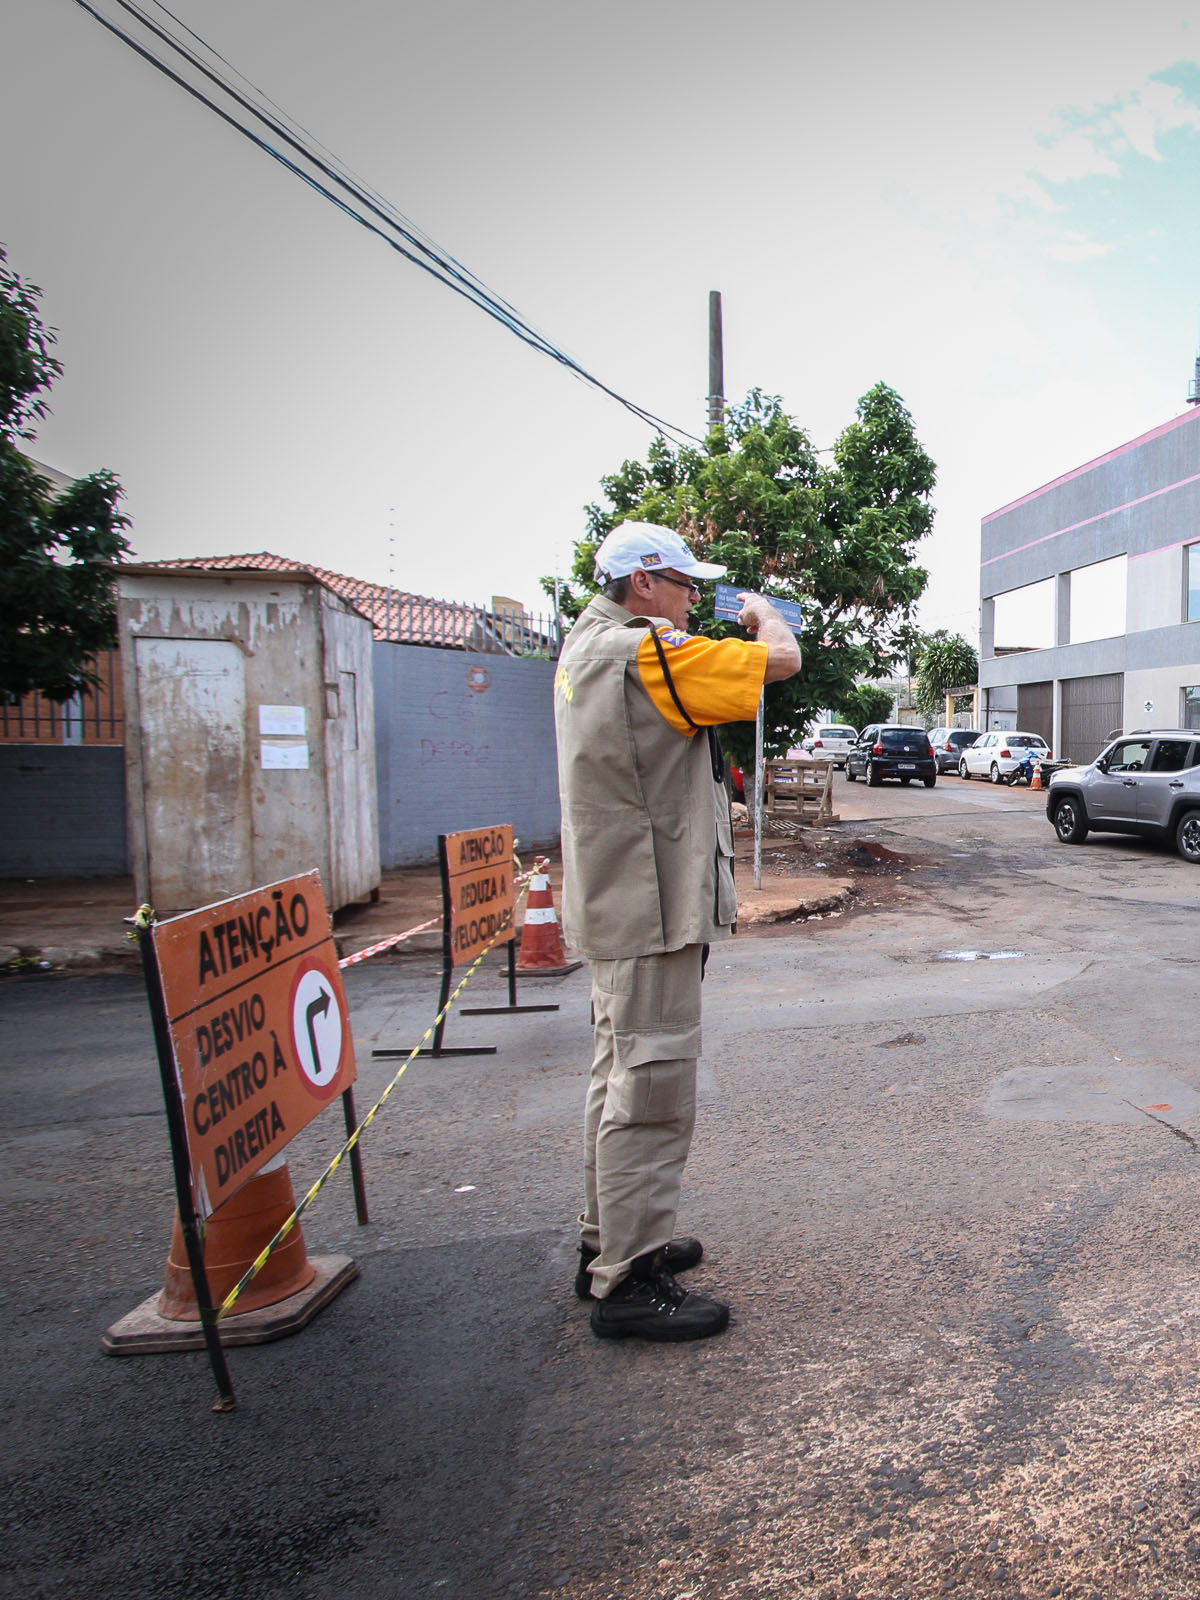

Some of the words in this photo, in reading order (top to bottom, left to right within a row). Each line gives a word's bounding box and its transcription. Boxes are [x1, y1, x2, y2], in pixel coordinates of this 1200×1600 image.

[460, 830, 505, 865] ATENÇÃO
[460, 877, 499, 911] REDUZA
[500, 873, 507, 897] A
[199, 891, 309, 985] ATENÇÃO
[196, 993, 265, 1066] DESVIO
[193, 1052, 268, 1137] CENTRO
[271, 1030, 288, 1077] À
[214, 1102, 286, 1187] DIREITA
